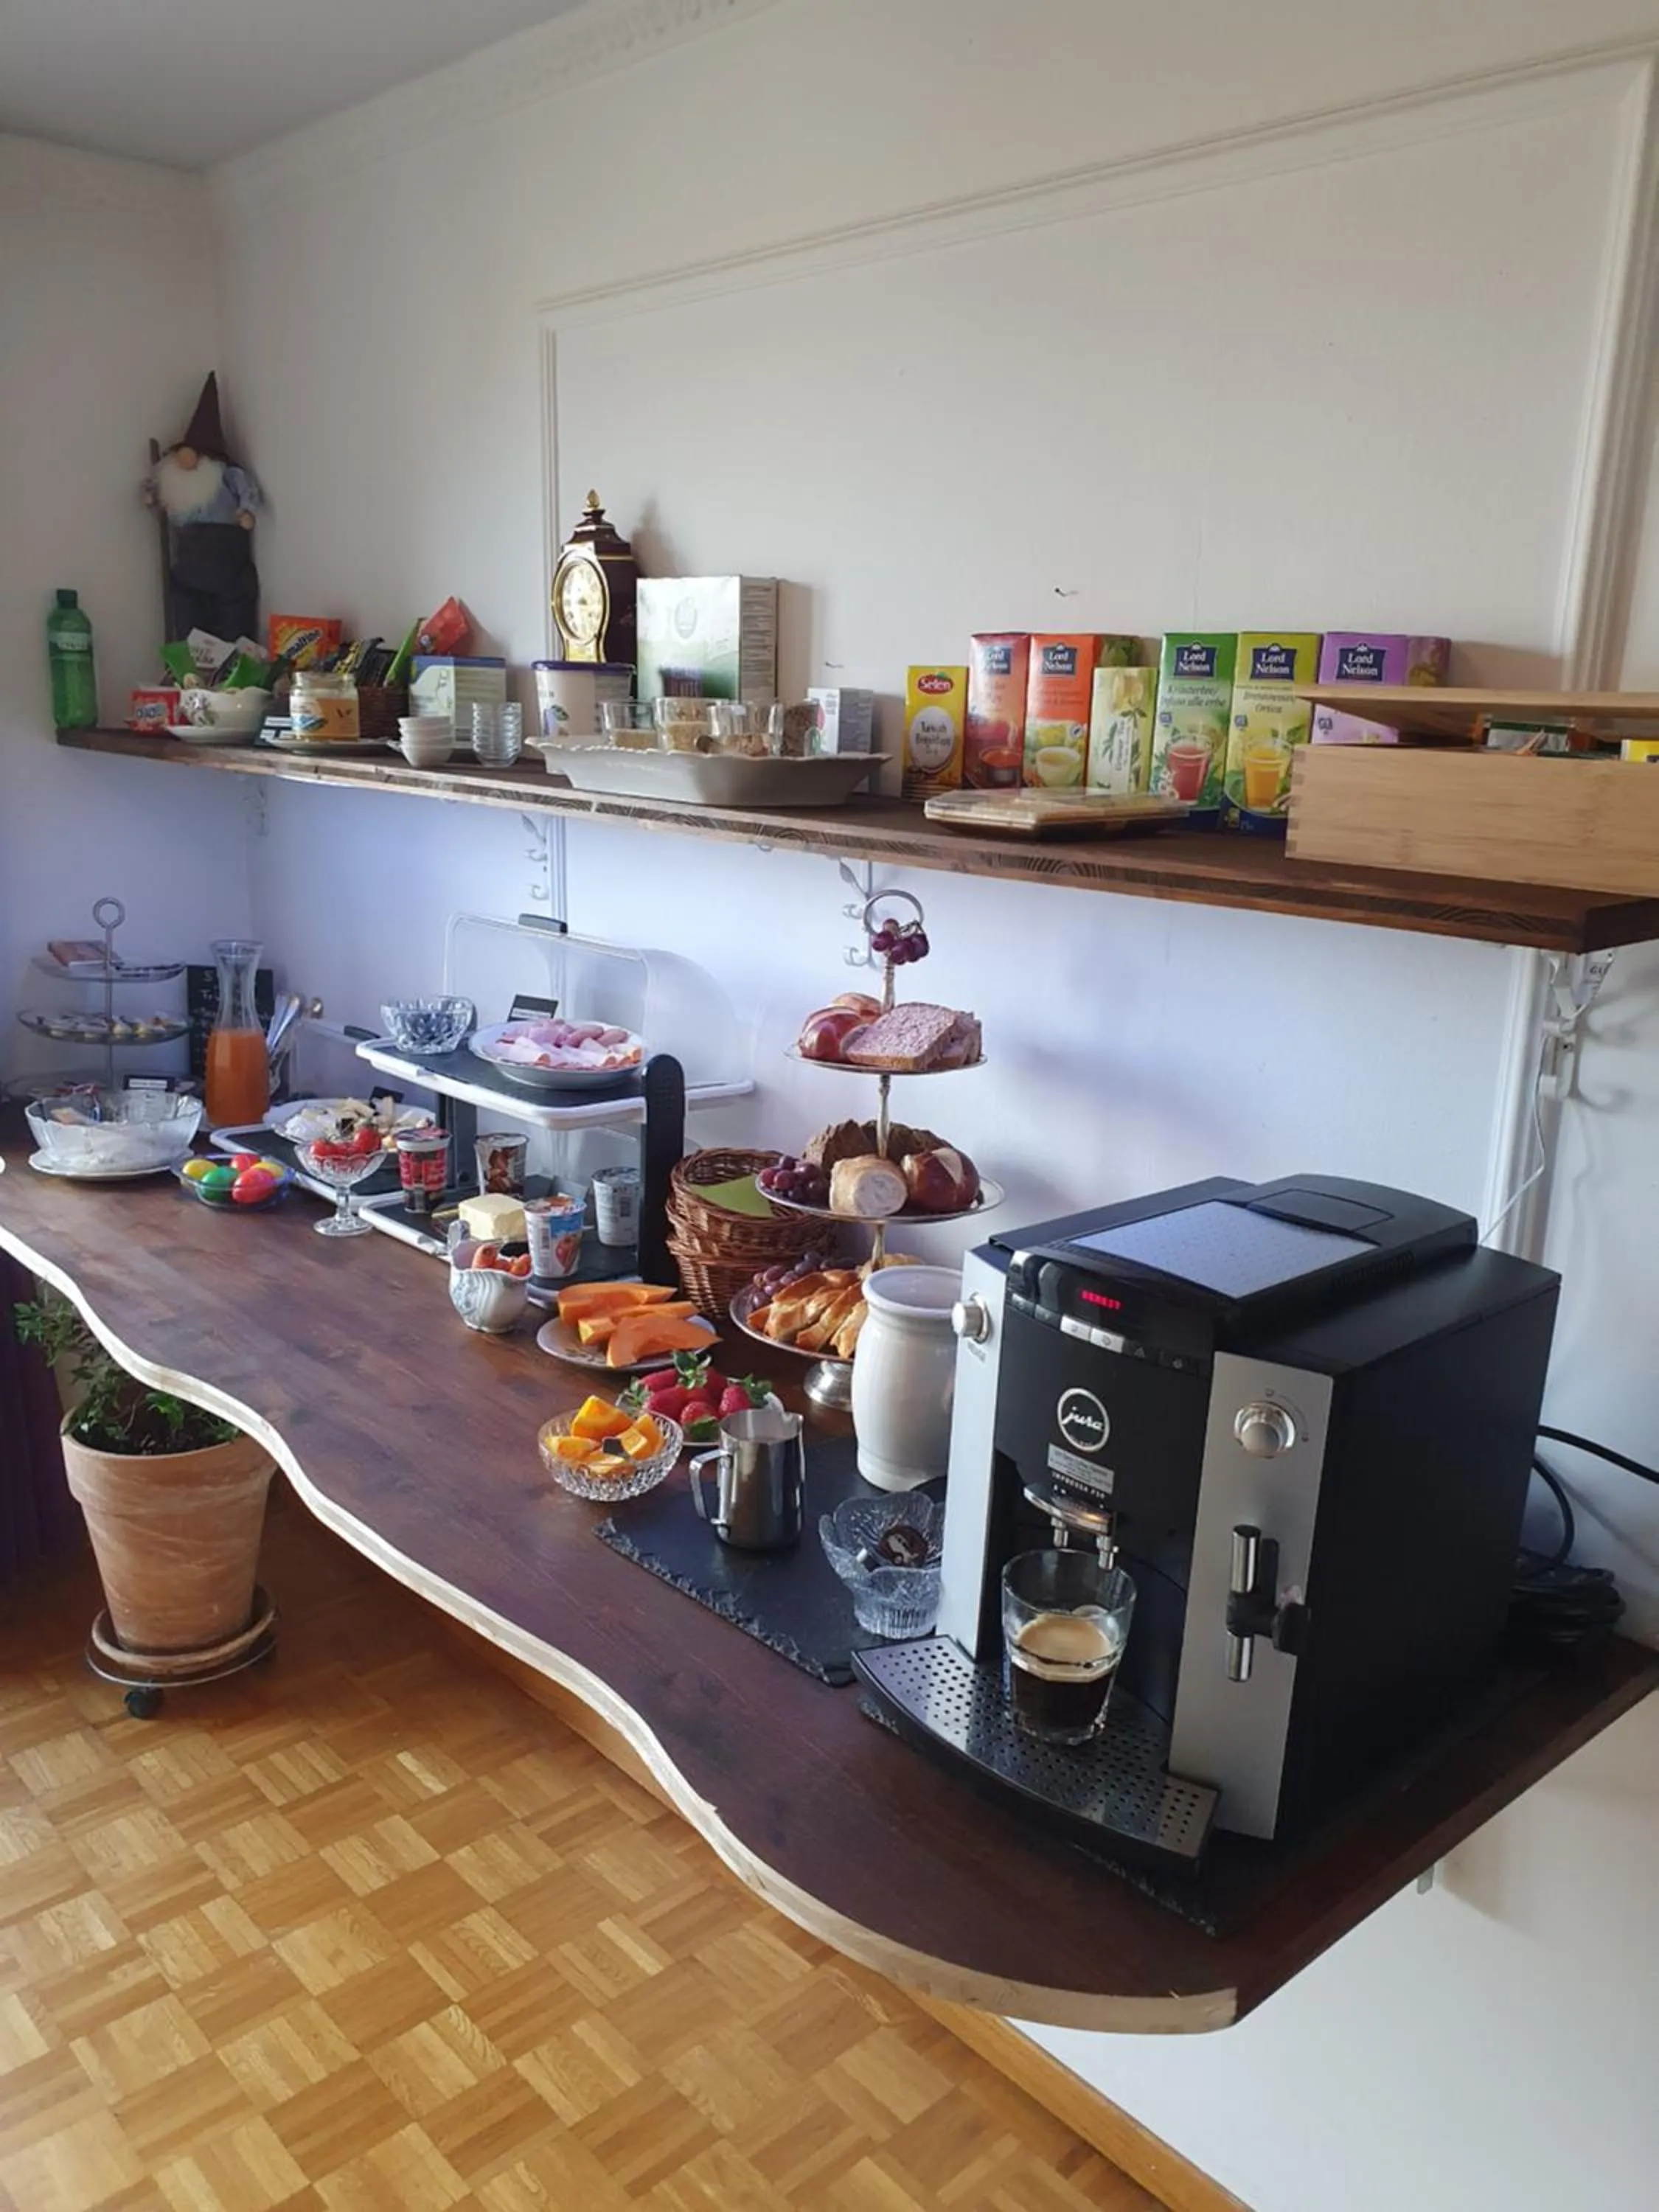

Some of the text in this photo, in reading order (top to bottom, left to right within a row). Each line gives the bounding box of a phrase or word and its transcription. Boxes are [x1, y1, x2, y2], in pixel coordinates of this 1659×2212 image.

[1048, 650, 1069, 661] Lord
[1183, 650, 1207, 661] Lord
[1261, 652, 1286, 663] Lord
[1347, 653, 1374, 664] Lord
[1178, 661, 1211, 672] Nelson
[1255, 663, 1290, 675] Nelson
[1341, 663, 1378, 676] Nelson
[1062, 1405, 1105, 1431] jura
